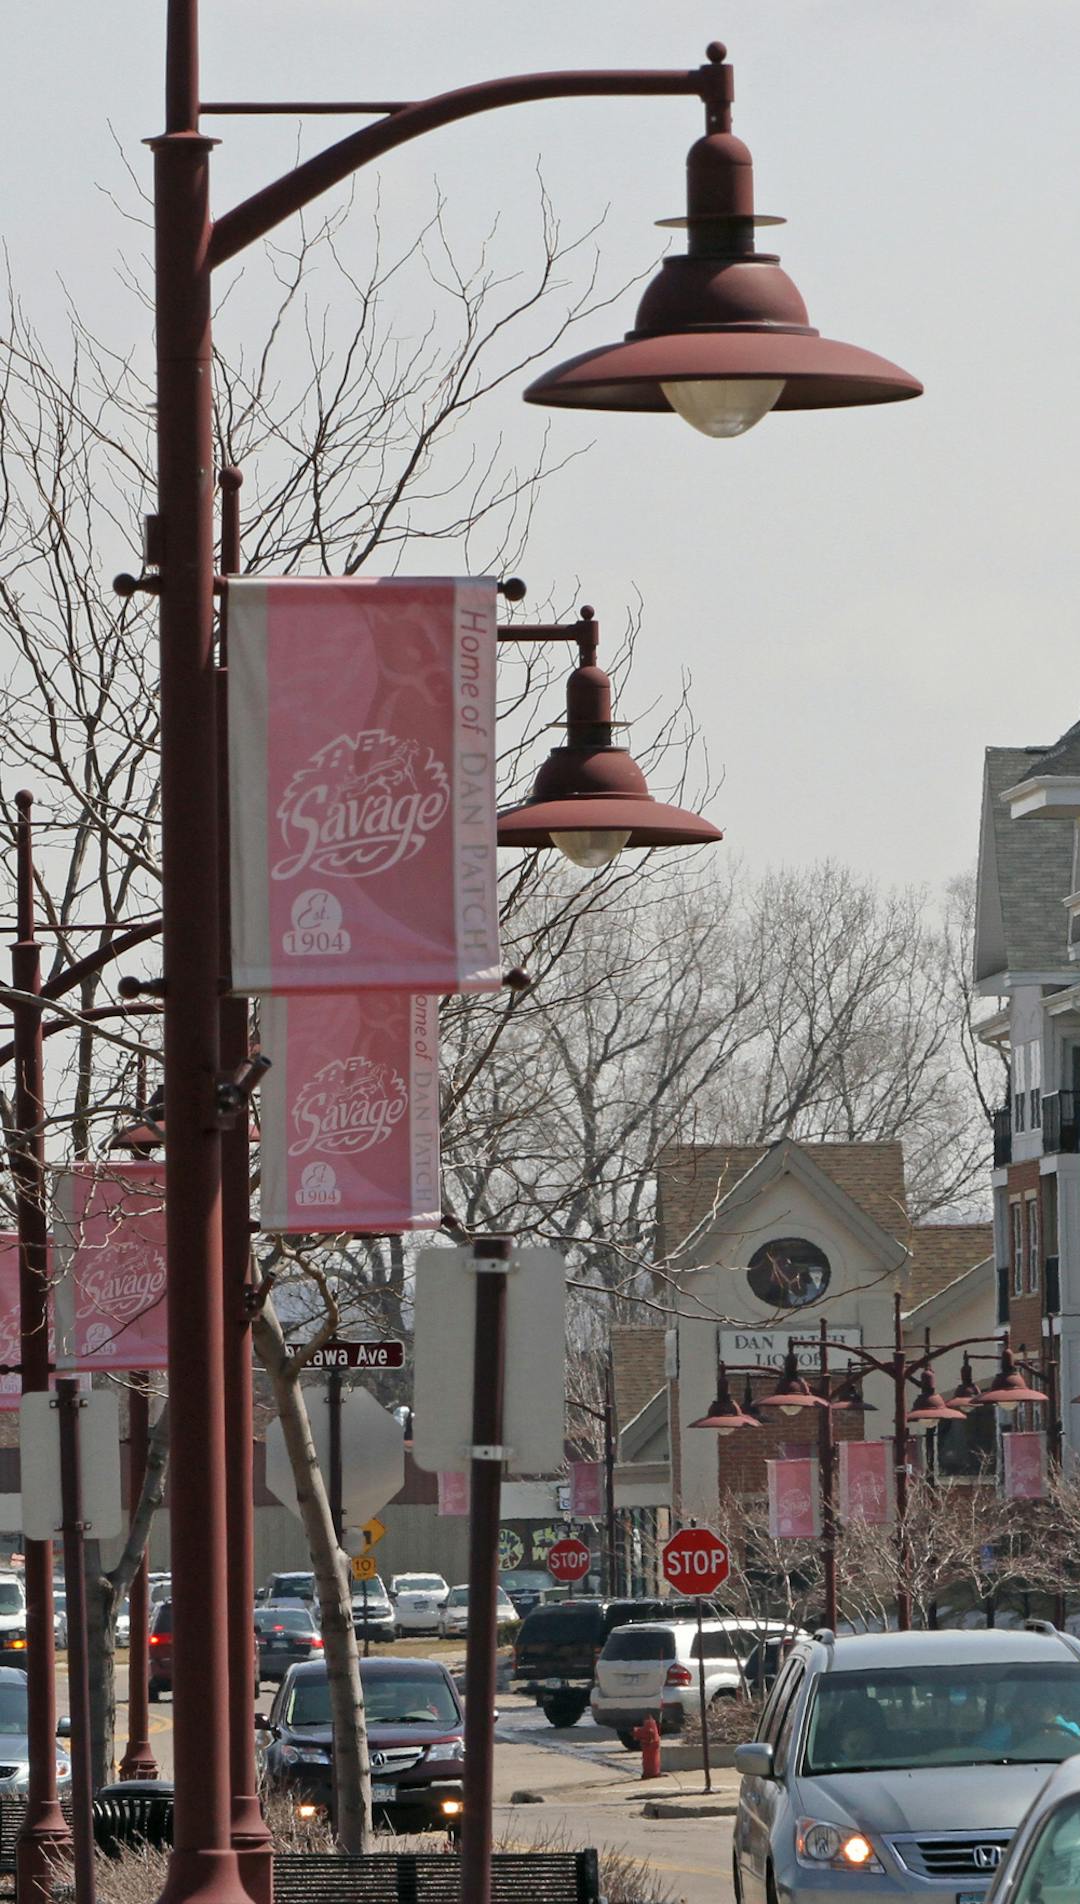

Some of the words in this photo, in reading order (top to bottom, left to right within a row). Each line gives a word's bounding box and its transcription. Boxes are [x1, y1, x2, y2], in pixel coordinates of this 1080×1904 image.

[461, 608, 487, 697] Home
[461, 708, 487, 737] of
[459, 751, 487, 826] DAN
[271, 784, 446, 881] Savage
[461, 843, 488, 953] PATCH
[287, 931, 345, 952] 1904
[415, 994, 428, 1037] ome
[415, 1040, 433, 1062] of
[415, 1071, 432, 1120] DAN
[288, 1092, 404, 1157] Savage
[415, 1132, 432, 1202] PATCH
[299, 1189, 337, 1205] 1904
[76, 1268, 165, 1319] Savage
[357, 1345, 388, 1365] Ave
[734, 1335, 775, 1350] DAN
[356, 1559, 371, 1571] 10
[550, 1551, 588, 1569] STOP
[667, 1550, 726, 1576] STOP
